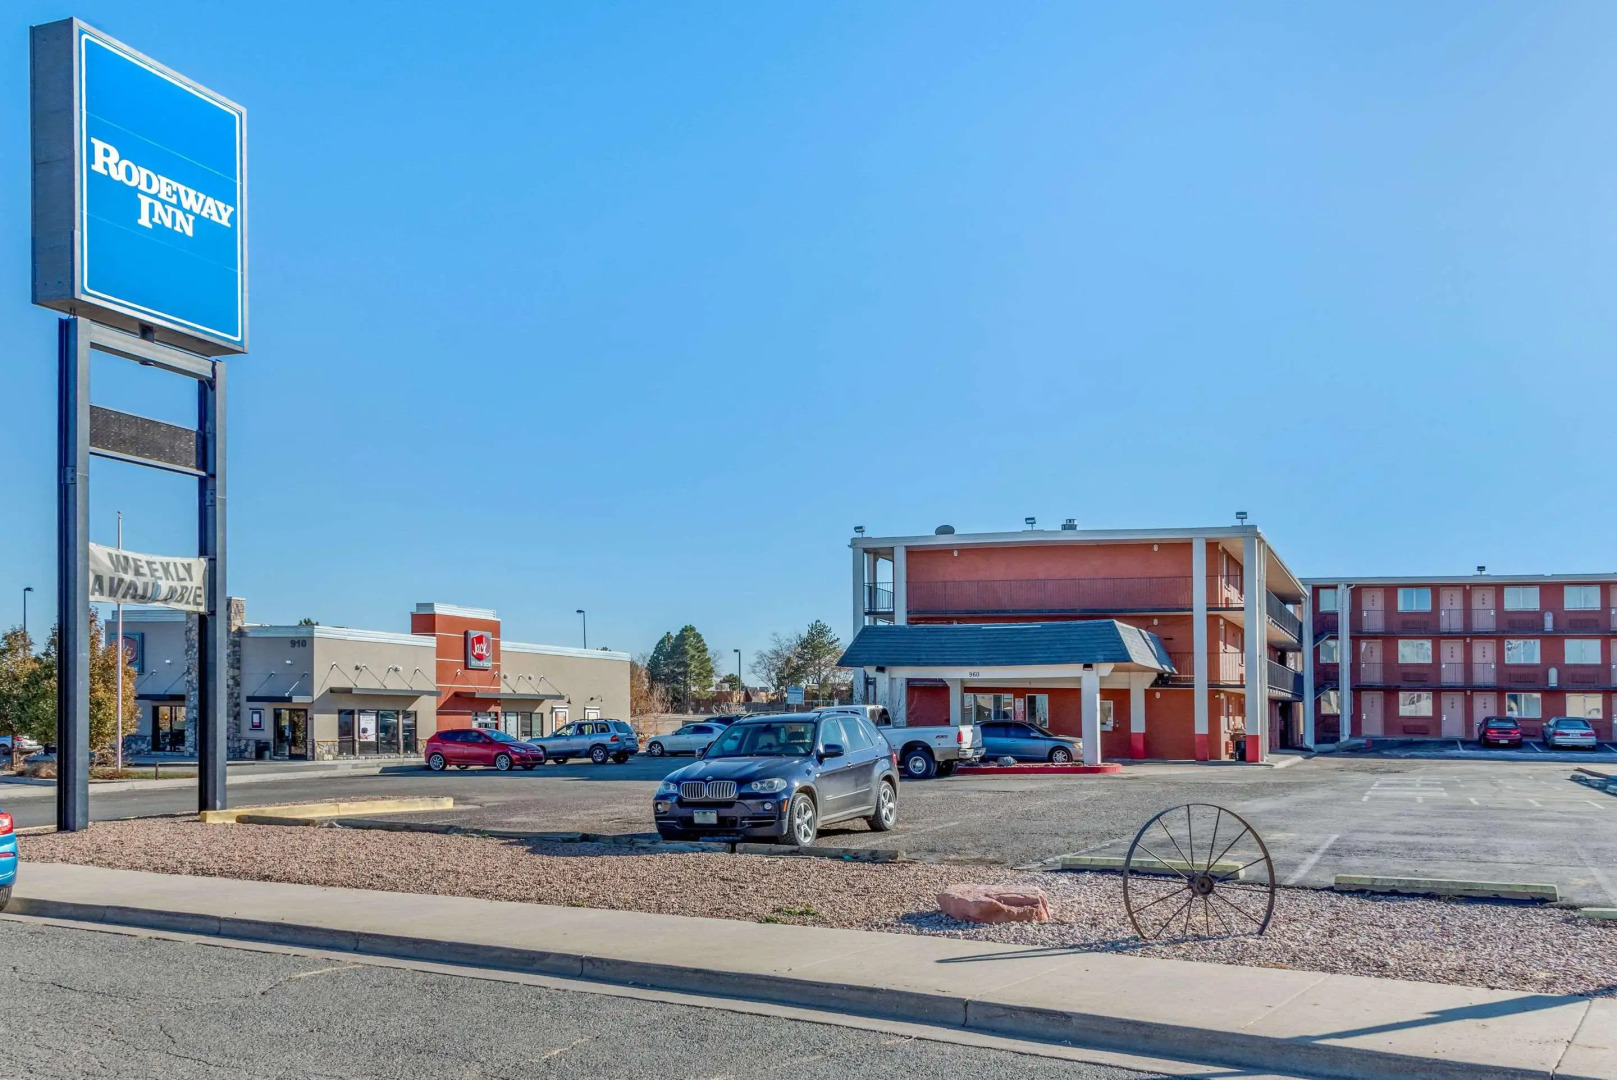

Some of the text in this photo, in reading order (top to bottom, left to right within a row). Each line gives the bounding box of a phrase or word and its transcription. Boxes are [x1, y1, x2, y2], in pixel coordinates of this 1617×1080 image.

[91, 136, 234, 228] RODEWAY
[137, 193, 195, 237] INN
[107, 552, 194, 582] WEEKLY
[290, 639, 307, 648] 910
[472, 636, 490, 657] Jack
